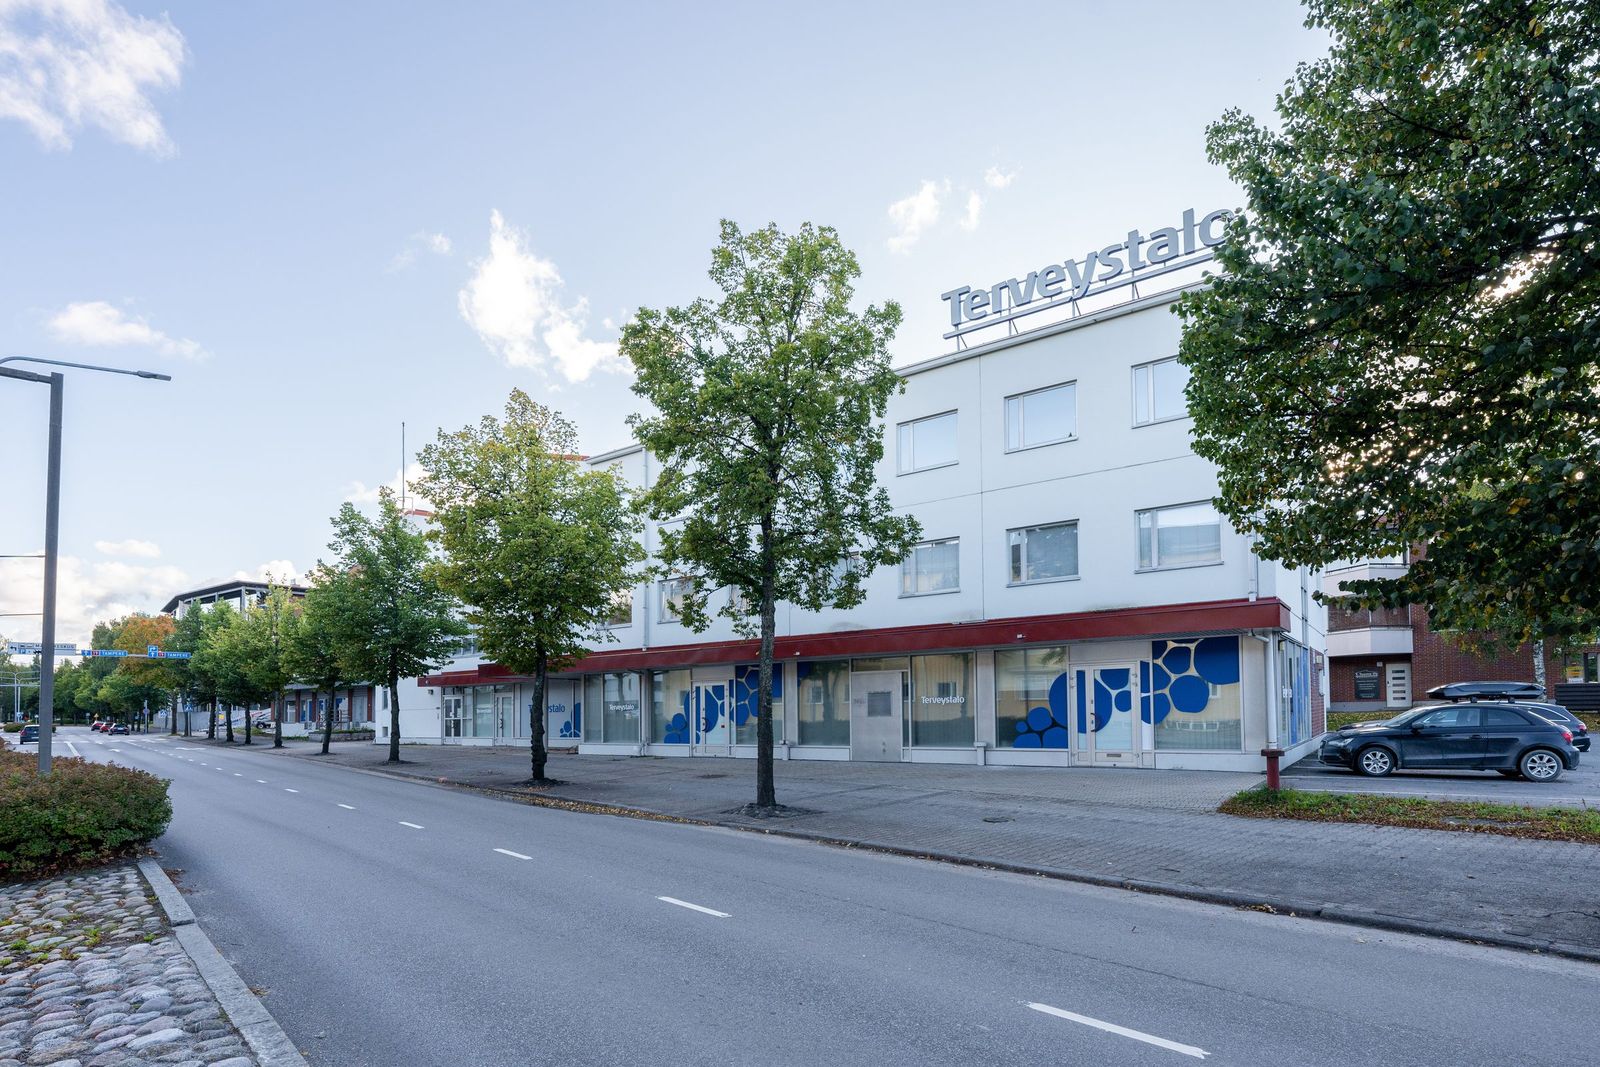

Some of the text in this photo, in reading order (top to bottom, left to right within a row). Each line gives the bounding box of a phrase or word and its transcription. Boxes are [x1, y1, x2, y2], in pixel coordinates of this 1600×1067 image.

[941, 208, 1234, 326] Terveystalo
[921, 695, 965, 706] Terveystalo
[609, 703, 635, 712] Terveystalo
